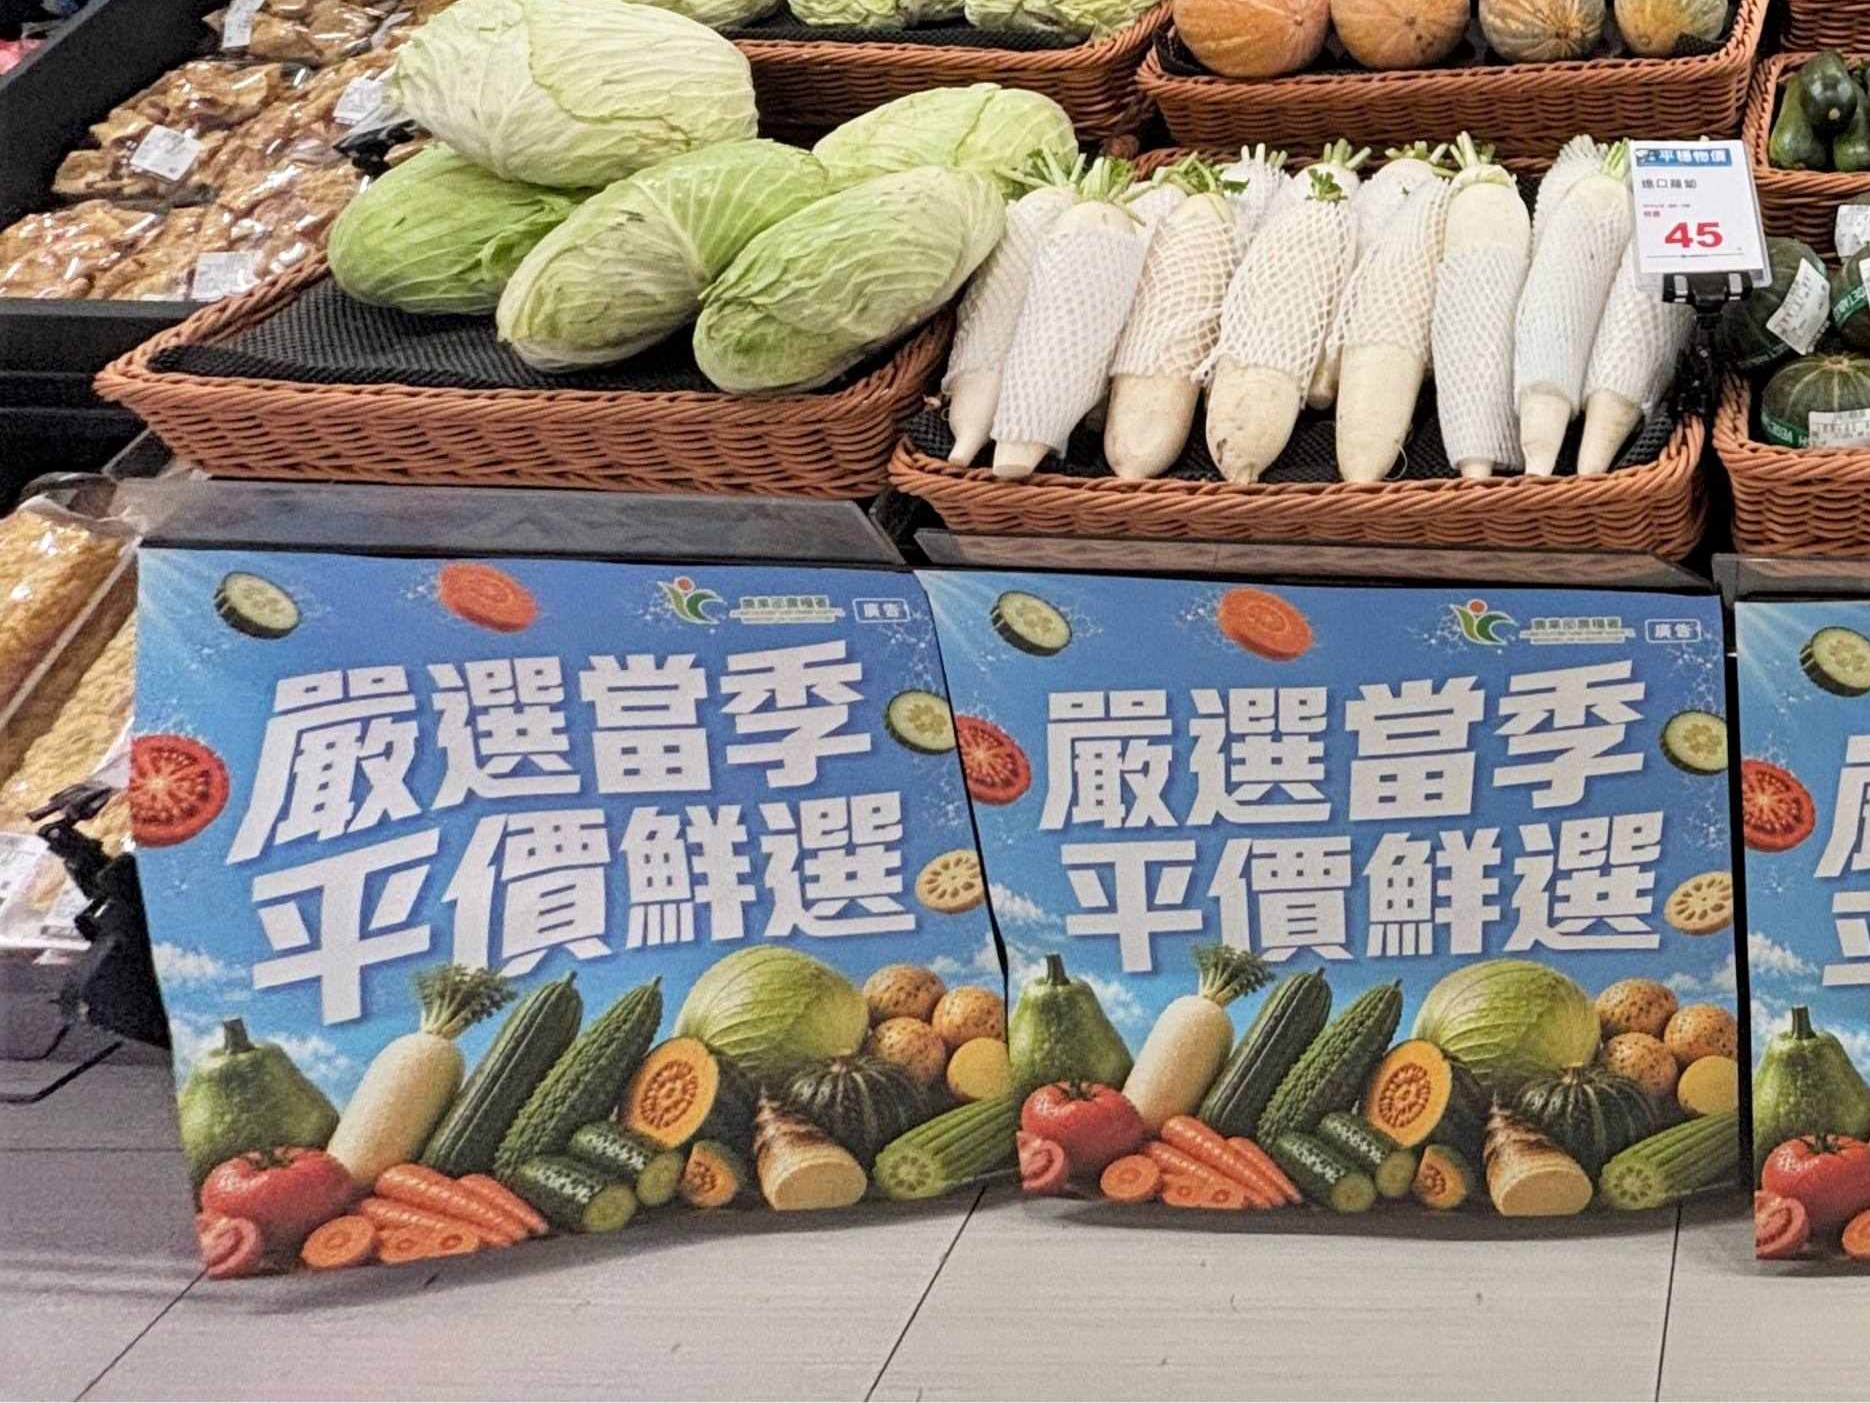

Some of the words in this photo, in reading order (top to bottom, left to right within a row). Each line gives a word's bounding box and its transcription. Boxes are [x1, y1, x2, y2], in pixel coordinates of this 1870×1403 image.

[1664, 221, 1725, 249] 45
[227, 640, 872, 865] 嚴選當季
[1039, 659, 1647, 830] 嚴選當季
[251, 791, 918, 1026] 平價鮮選
[1061, 810, 1664, 972] 平價鮮選
